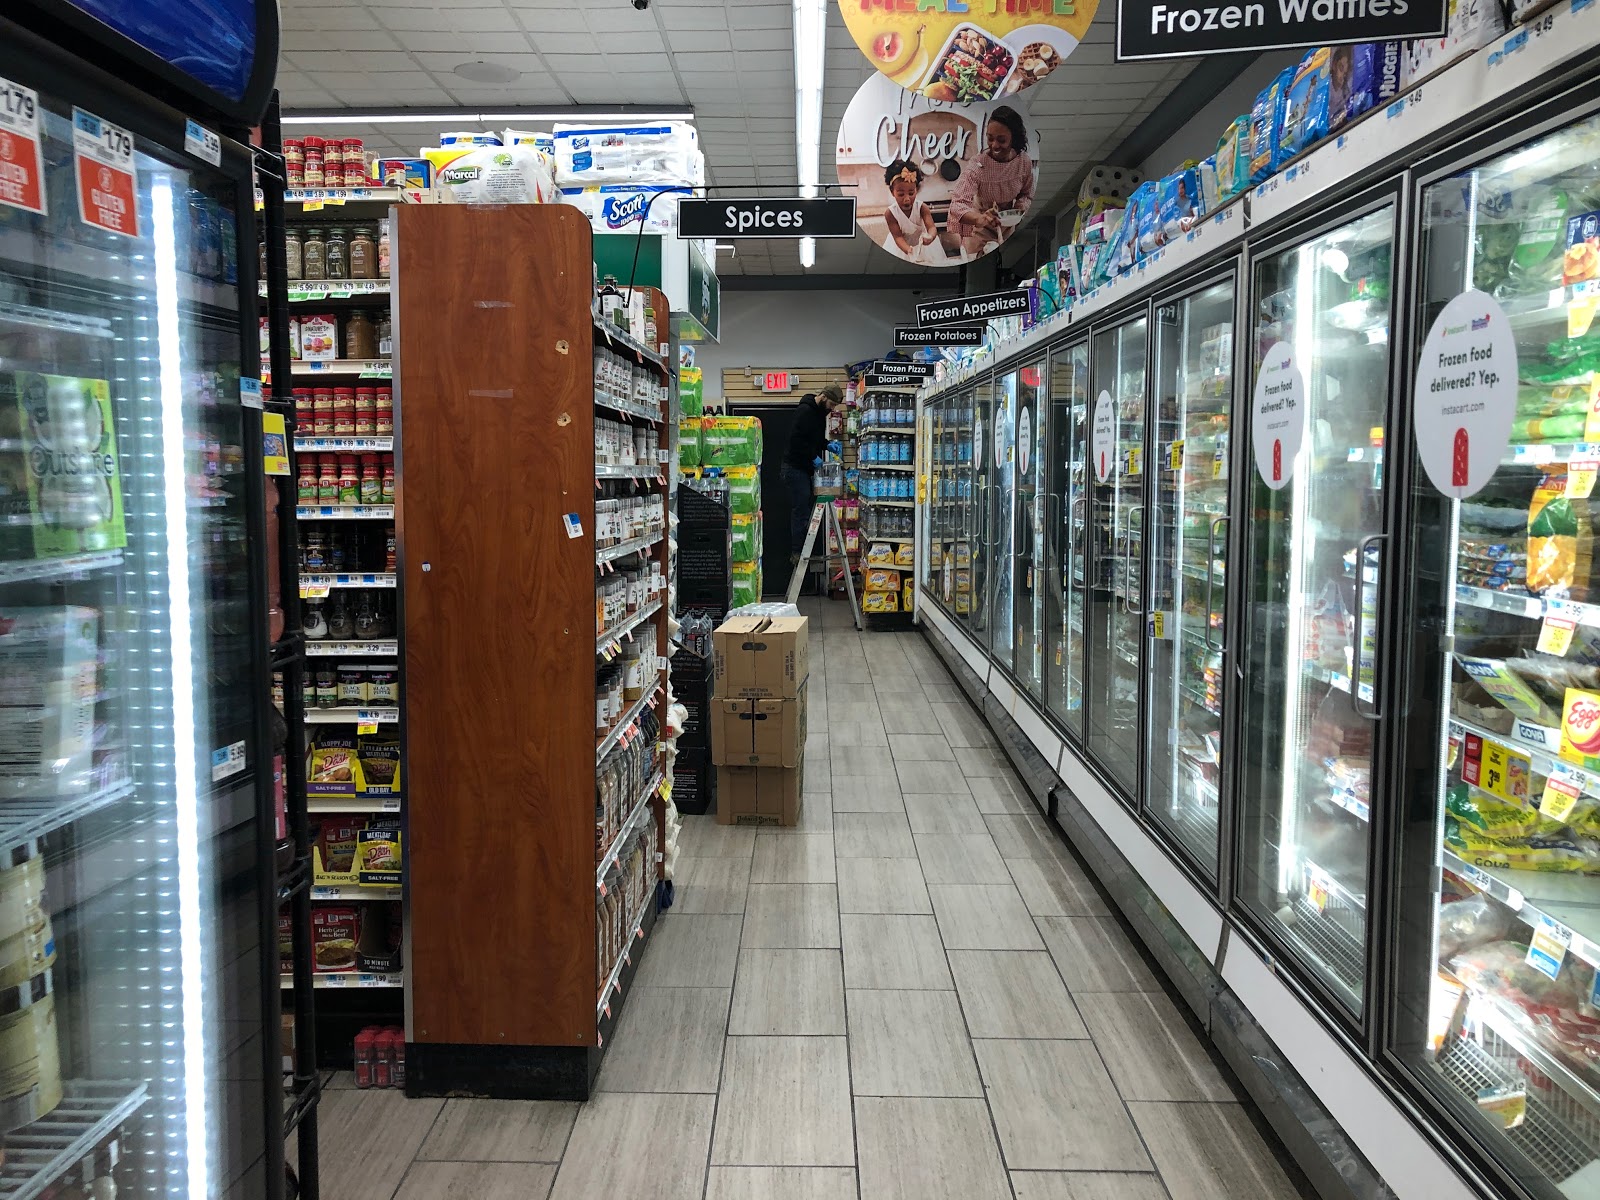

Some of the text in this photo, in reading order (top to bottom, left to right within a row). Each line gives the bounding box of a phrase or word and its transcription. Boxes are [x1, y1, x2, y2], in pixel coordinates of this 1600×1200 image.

[1151, 4, 1264, 36] Frozen
[1379, 41, 1398, 97] HUGGIE
[444, 169, 478, 182] Marcal
[610, 193, 644, 221] Scott
[725, 205, 803, 233] Spices
[920, 296, 1027, 322] Frozen Appetizers
[899, 331, 978, 342] Frozen Potatoes
[1438, 343, 1493, 368] Frozen food
[882, 364, 927, 374] Frozen Pizza
[767, 372, 788, 390] EXIT
[878, 375, 910, 384] Diapers
[1430, 370, 1500, 393] delivered? Yep.
[1441, 401, 1485, 416] instacart.com
[1520, 725, 1545, 743] GOYA
[341, 740, 352, 748] JOE
[323, 753, 349, 768] Dash
[758, 815, 779, 825] Spring
[366, 831, 392, 839] MEATLOAF
[367, 846, 391, 860] Dash
[333, 927, 349, 935] Gravy
[371, 959, 390, 967] MINUTE
